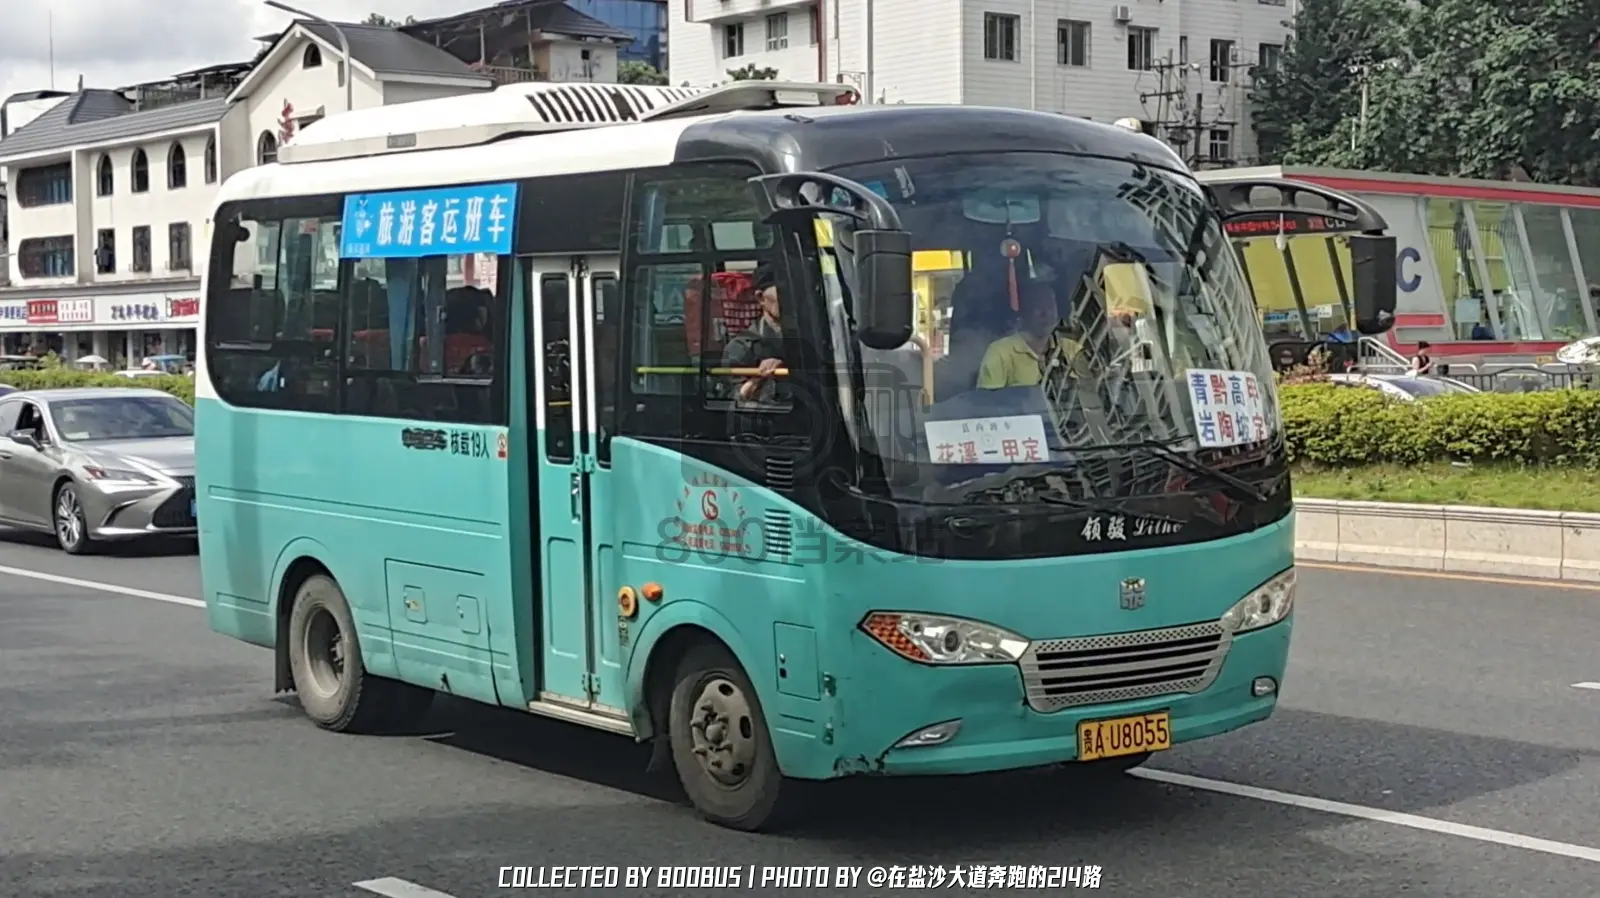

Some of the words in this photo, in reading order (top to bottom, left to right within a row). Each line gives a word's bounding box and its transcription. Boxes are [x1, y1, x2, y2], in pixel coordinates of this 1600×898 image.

[376, 194, 508, 247] 旅游客运班车
[1191, 372, 1217, 442] 青岩
[1209, 374, 1236, 443] 黔陶
[1228, 375, 1251, 442] 高坡
[450, 430, 490, 459] 核载19人
[1081, 516, 1127, 541] 领骏
